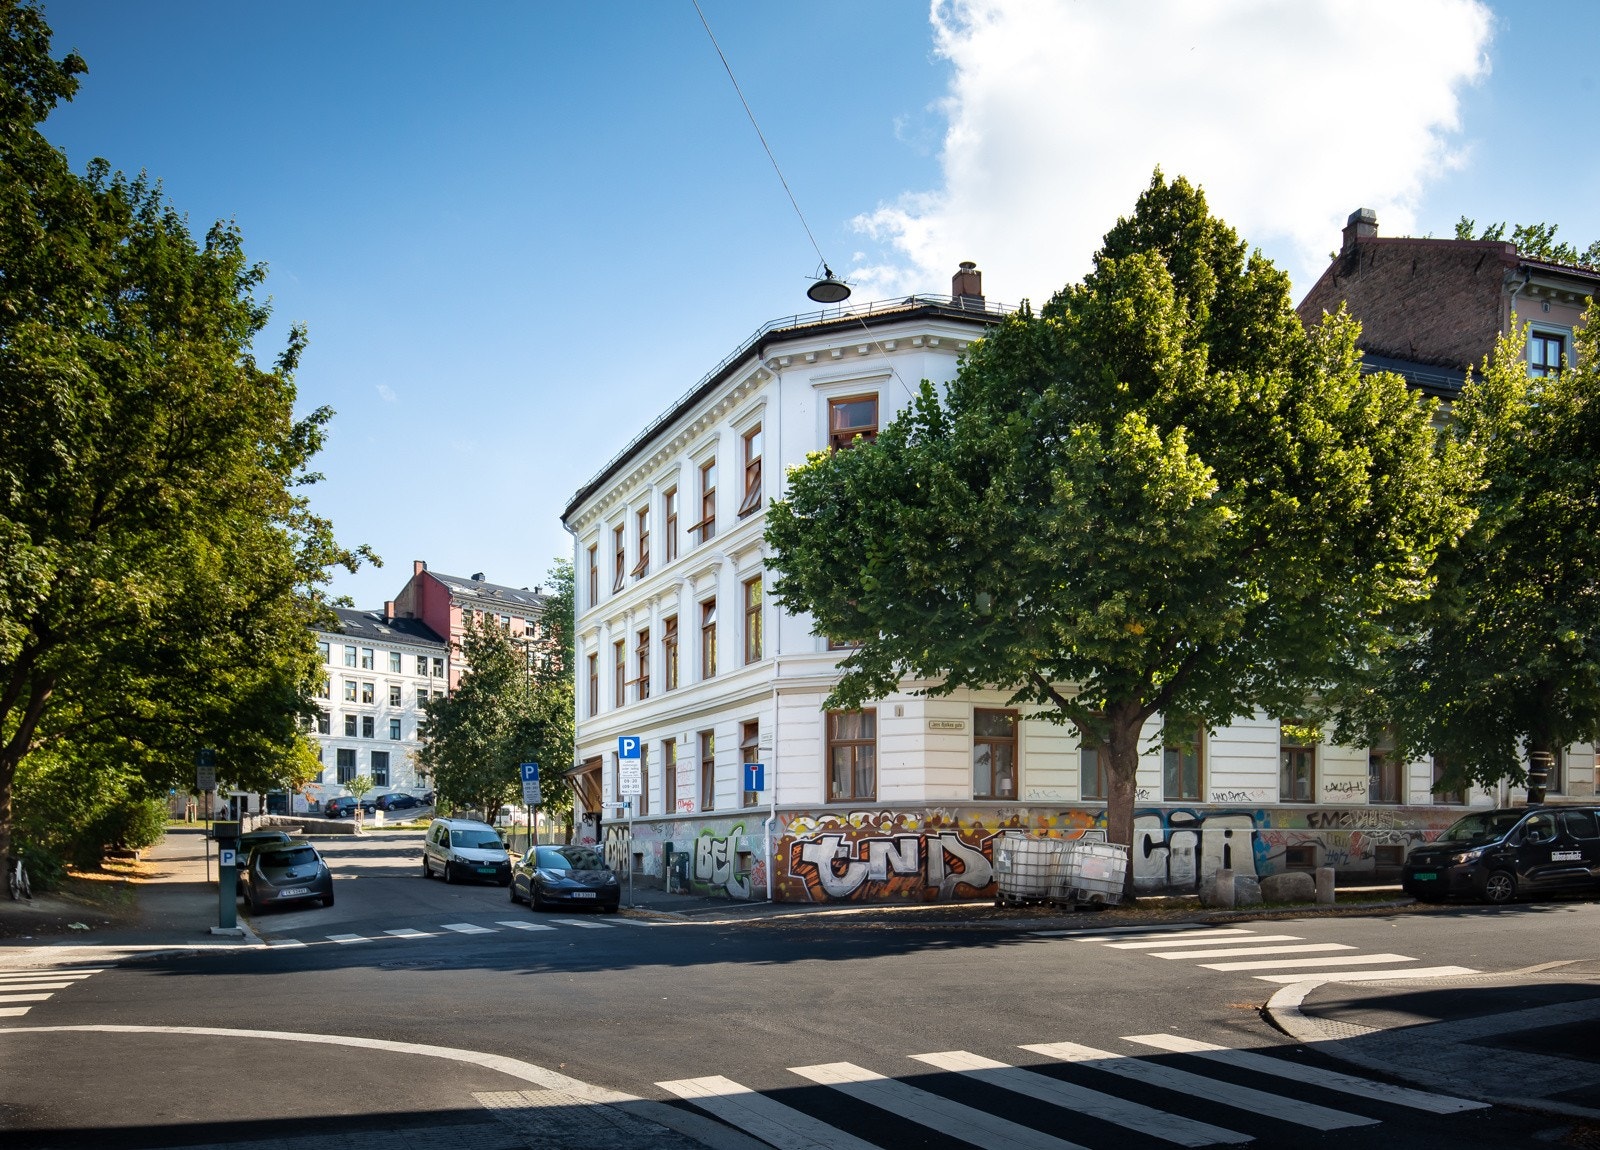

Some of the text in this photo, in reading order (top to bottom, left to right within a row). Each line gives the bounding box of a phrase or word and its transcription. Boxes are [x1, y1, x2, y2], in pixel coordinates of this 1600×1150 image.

[624, 739, 635, 757] P
[525, 765, 534, 779] P
[224, 852, 233, 863] P
